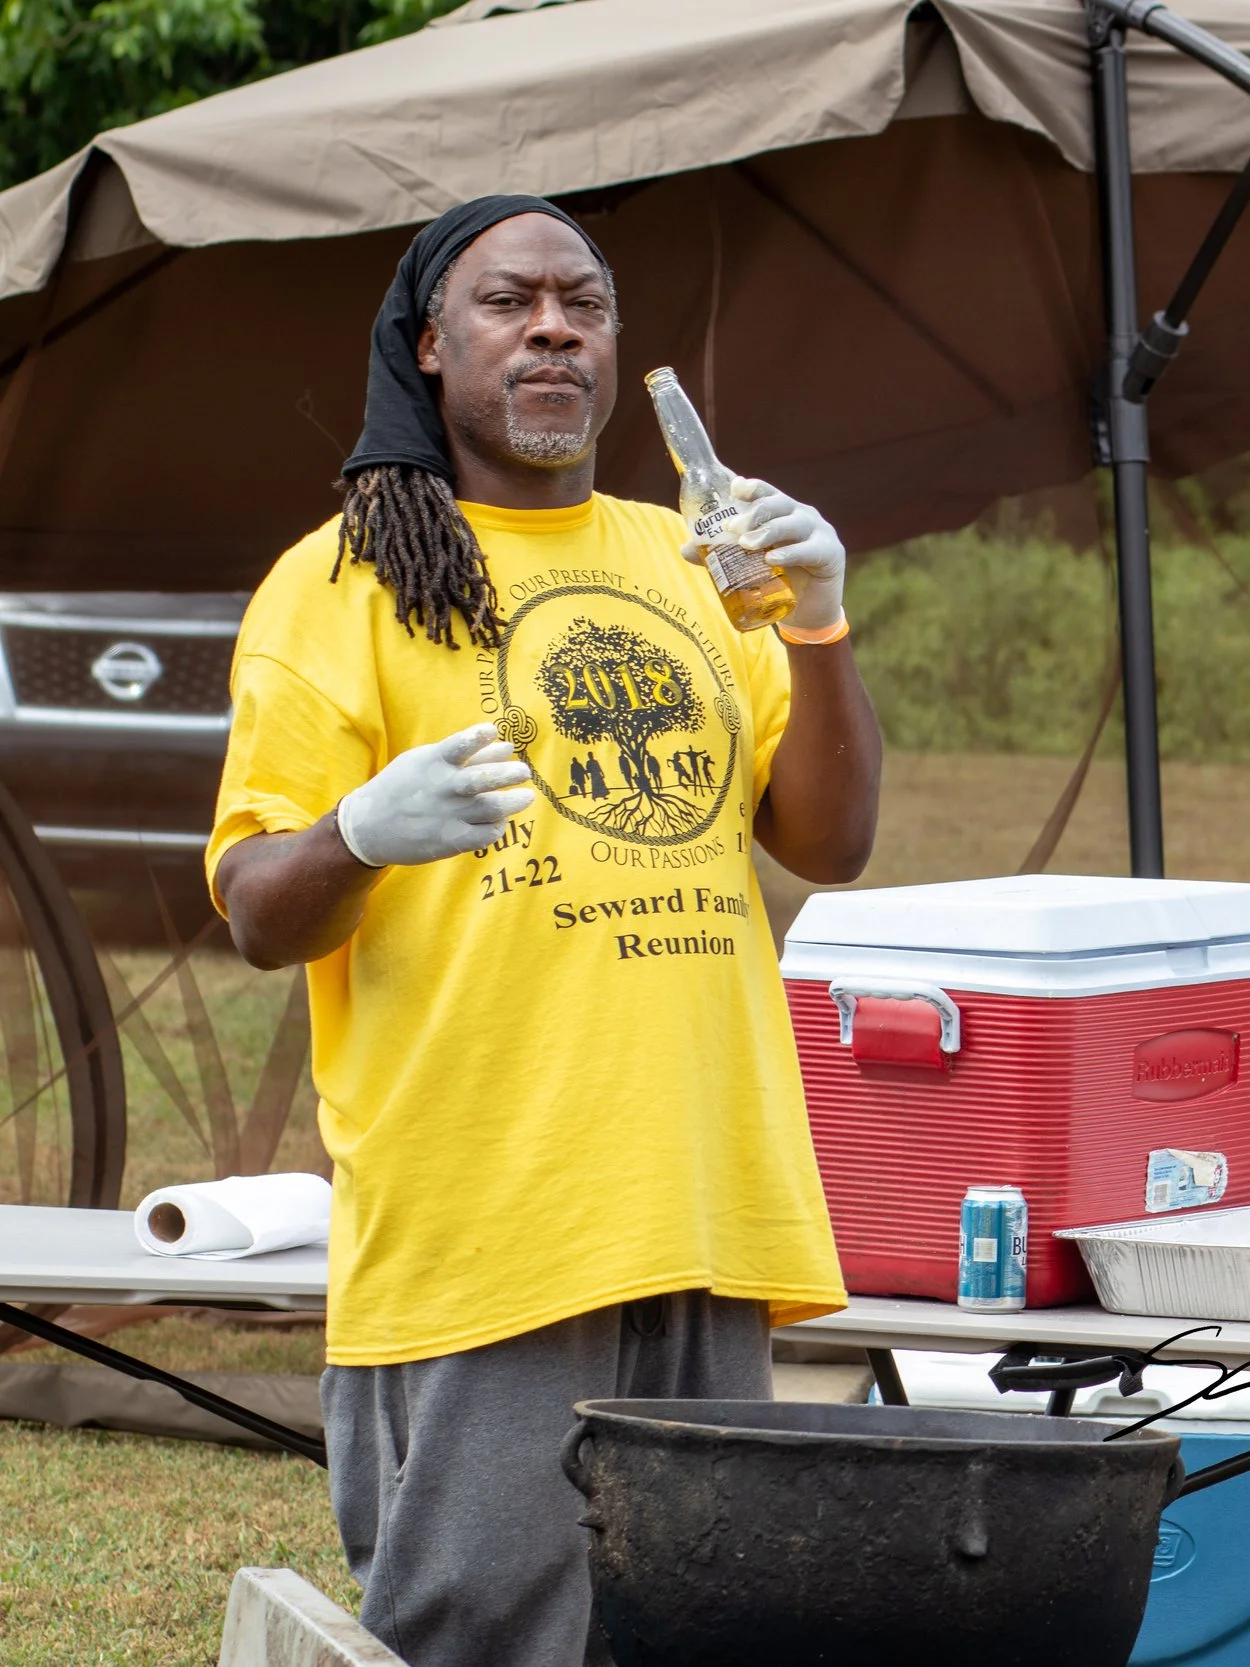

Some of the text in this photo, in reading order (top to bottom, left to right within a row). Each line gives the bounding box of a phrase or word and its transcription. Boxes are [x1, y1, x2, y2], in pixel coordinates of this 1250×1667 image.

[695, 507, 739, 536] Corona
[550, 659, 684, 713] 2018
[474, 820, 535, 858] uly
[480, 855, 562, 901] 21-22
[553, 888, 685, 930] Seward
[613, 930, 736, 960] Reunion
